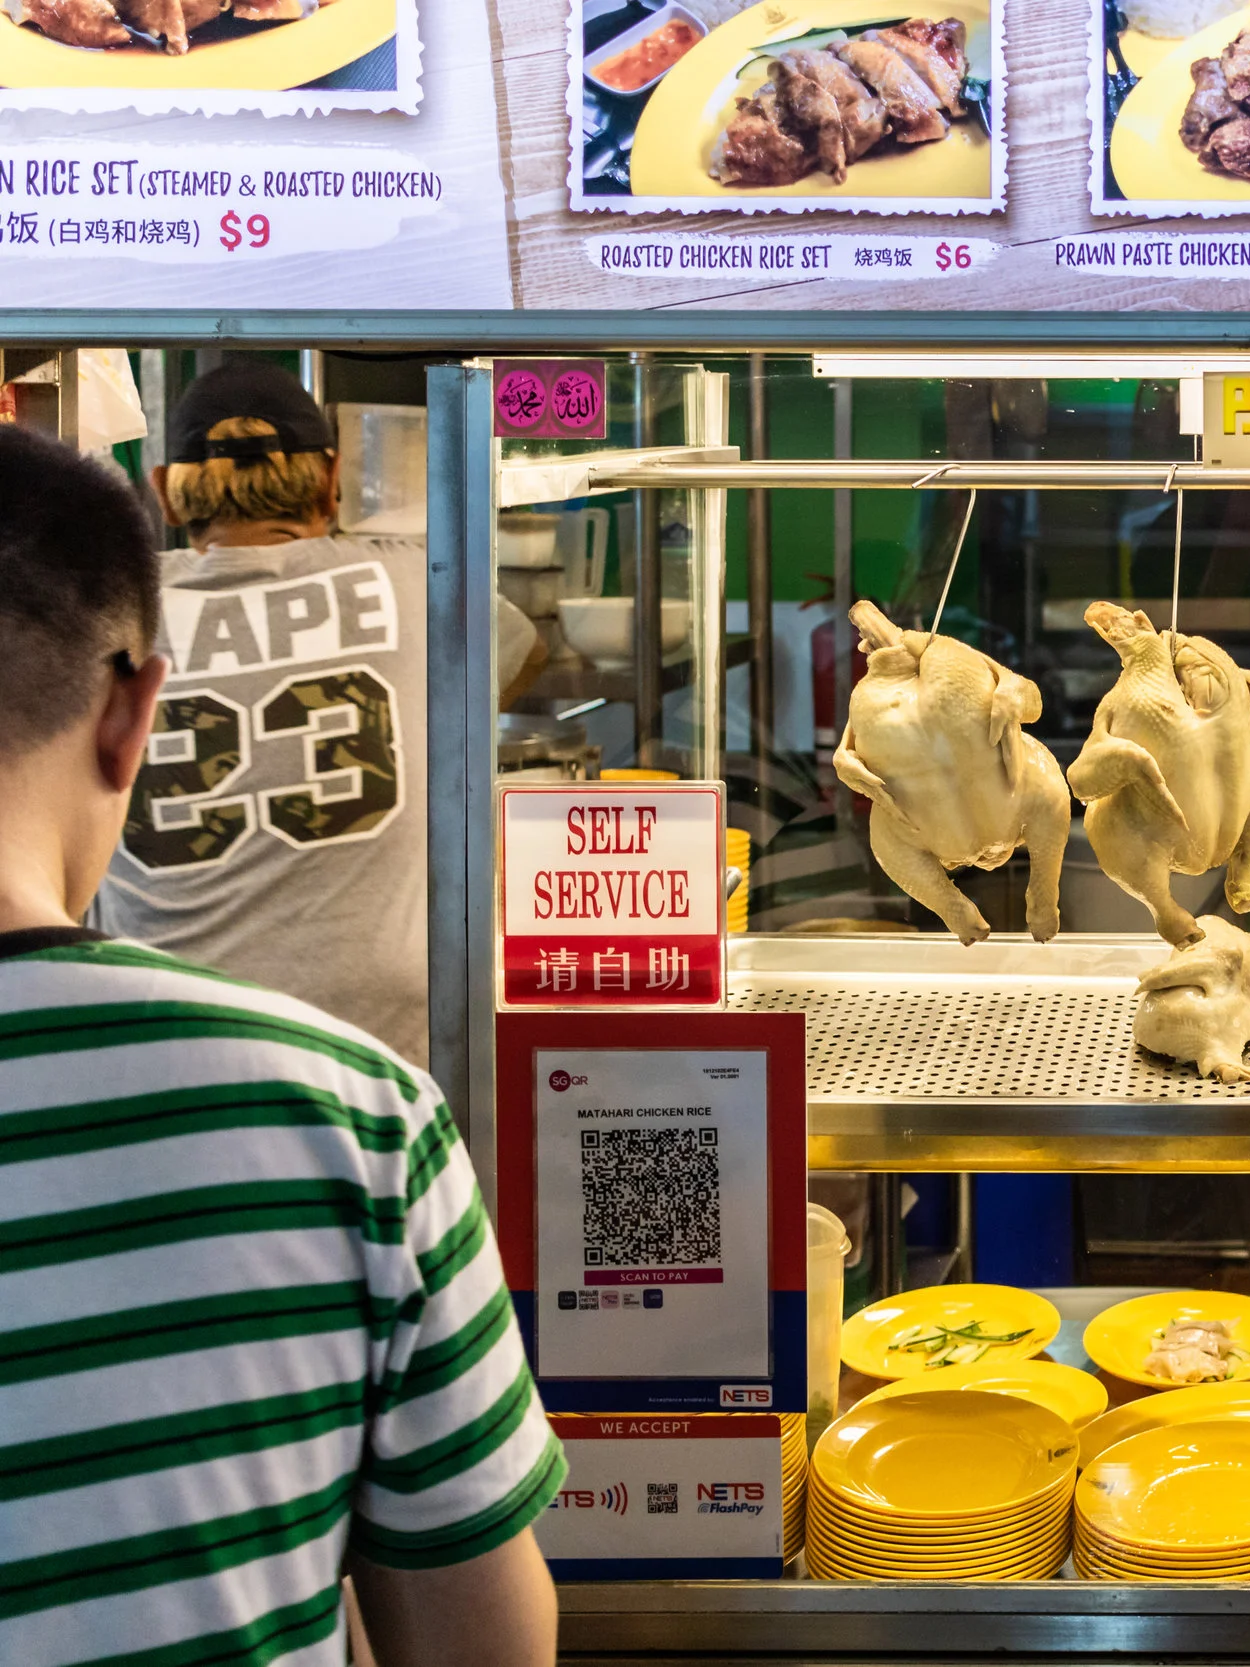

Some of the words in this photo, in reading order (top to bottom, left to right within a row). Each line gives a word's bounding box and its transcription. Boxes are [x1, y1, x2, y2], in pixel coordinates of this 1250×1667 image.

[26, 160, 80, 196] RICE
[92, 160, 138, 196] SET
[139, 170, 231, 199] (STEAMED
[239, 175, 256, 197] &
[264, 171, 345, 198] ROASTED
[352, 171, 442, 200] CHICKEN)
[49, 219, 200, 247] (白鸡和烧鸡)
[219, 210, 270, 252] $9
[601, 244, 673, 269] ROASTED
[680, 244, 752, 269] CHICKEN
[760, 245, 795, 269] RICE
[801, 245, 832, 269] SET
[854, 247, 913, 267] 烧鸡饭
[935, 242, 972, 272] $6
[1055, 242, 1115, 267] PRAWN
[1123, 242, 1173, 267] PASTE
[1180, 243, 1250, 267] CHICKEN
[157, 565, 390, 674] APE
[122, 664, 405, 875] 23
[567, 805, 657, 855] SELF
[534, 869, 690, 919] SERVICE
[534, 947, 690, 992] 请自助
[577, 1109, 634, 1118] MATAHARI
[636, 1107, 684, 1117] CHICKEN
[686, 1107, 712, 1116] RICE
[620, 1272, 648, 1281] SCAN
[652, 1272, 666, 1281] TO
[668, 1272, 689, 1281] PAY
[722, 1389, 770, 1402] NETS
[601, 1421, 624, 1434] WE
[629, 1420, 691, 1434] ACCEPT
[697, 1482, 765, 1501] NETS
